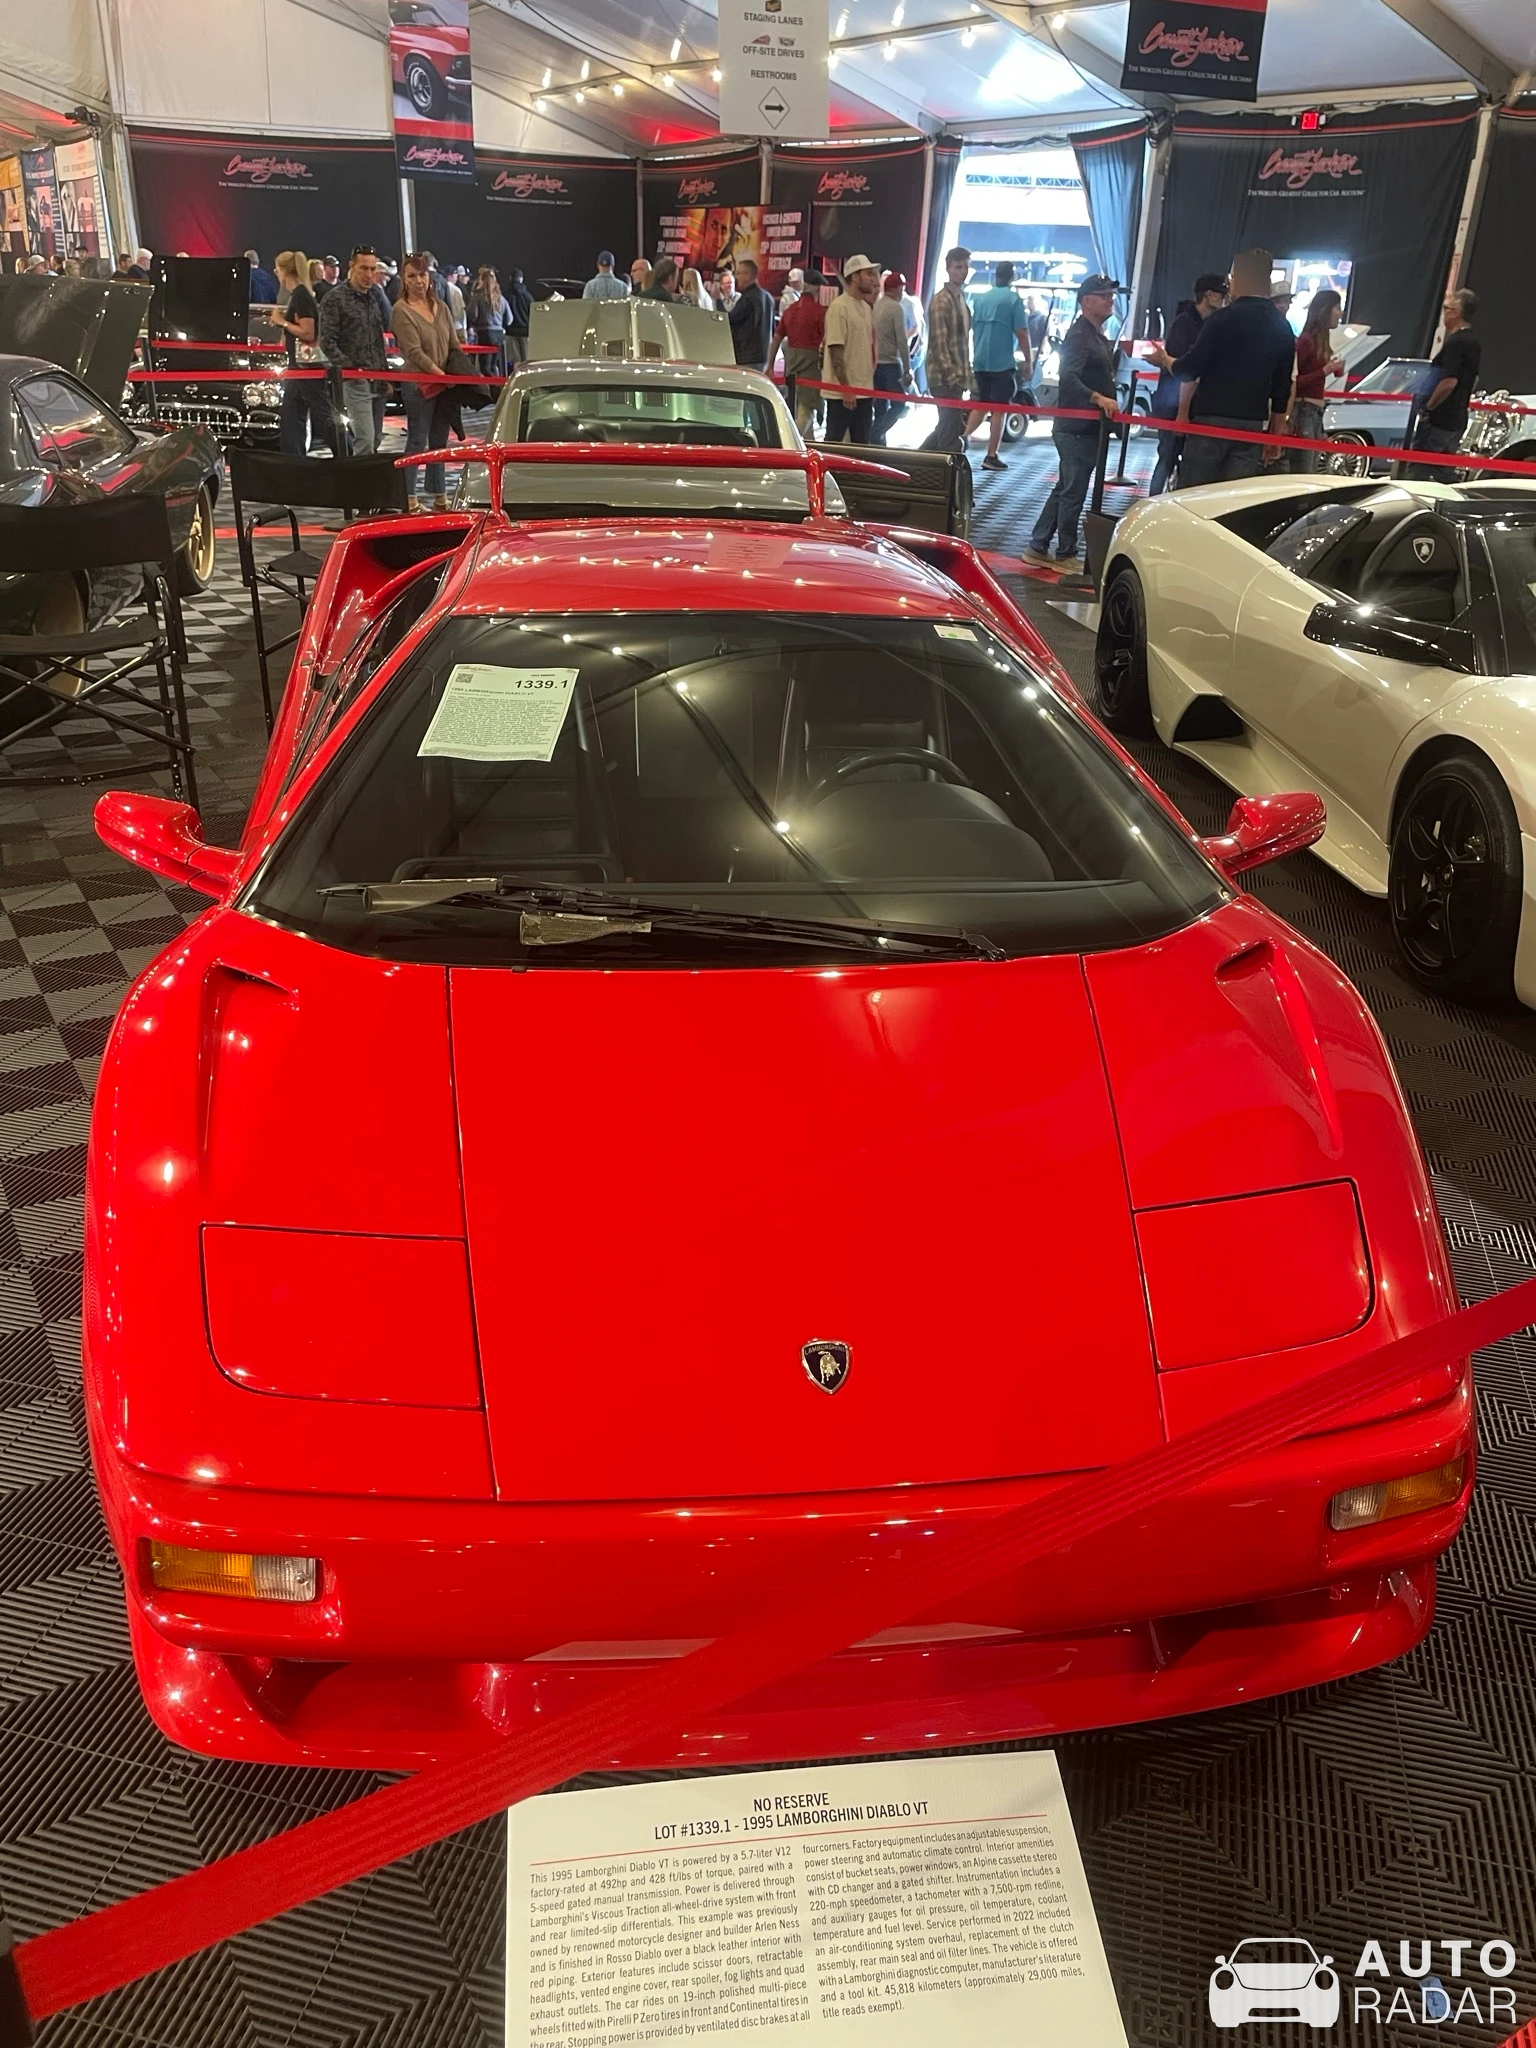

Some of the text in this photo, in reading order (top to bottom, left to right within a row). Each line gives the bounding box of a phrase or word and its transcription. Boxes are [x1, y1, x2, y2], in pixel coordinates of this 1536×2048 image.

[744, 12, 803, 25] STAGING LANES
[743, 45, 805, 58] OFF-SITE DRIVES
[751, 70, 797, 80] RESTROOMS
[515, 680, 568, 689] 1339.1
[804, 1344, 846, 1355] LAMBORGHINI
[753, 1792, 829, 1812] NO RESERVE
[654, 1825, 675, 1840] LOT
[680, 1820, 730, 1838] #1339.1
[744, 1816, 773, 1832] 1995
[776, 1807, 863, 1829] LAMBORGHINI
[866, 1803, 911, 1821] DIABLO
[913, 1801, 927, 1816] VT
[530, 1872, 547, 1884] This
[551, 1869, 572, 1881] 1995
[575, 1863, 627, 1879] Lamborghini
[629, 1860, 656, 1873] Diablo
[658, 1858, 668, 1870] VT
[672, 1858, 679, 1868] is
[682, 1853, 717, 1869] powered
[719, 1852, 729, 1865] by
[740, 1848, 771, 1861] 5.7-liter
[775, 1845, 791, 1857] V12
[530, 1881, 585, 1898] factory-rated
[588, 1881, 596, 1892] at
[600, 1878, 627, 1891] 492hp
[630, 1875, 645, 1887] and
[649, 1873, 665, 1885] 428
[668, 1871, 691, 1883] ft/lbs
[694, 1869, 702, 1880] of
[705, 1868, 734, 1880] torque,
[738, 1862, 764, 1878] paired
[767, 1860, 784, 1872] with
[530, 1873, 795, 1914] 5-speed gated manual transmission. Power is delivered through
[809, 1897, 847, 1911] 220-mph
[850, 1894, 905, 1909] speedometer,
[914, 1889, 960, 1902] tachometer
[963, 1885, 980, 1897] with
[991, 1882, 1032, 1896] 7,500-rpm
[1034, 1879, 1064, 1891] redline,
[811, 1893, 1067, 1925] and auxiliary gauges for oil pressure, oil temperature, coolant
[530, 1903, 798, 1943] and rear limited-slip differentials. This example was previously
[530, 1919, 800, 1958] owned by renowned motorcycle designer and builder Arlen Ness
[813, 1906, 1071, 1942] temperature and fuel level. Service performed in 2022 included
[815, 1920, 1074, 1956] an air-conditioning system overhaul, replacement of the clutch
[530, 1947, 803, 1989] red piping. Exterior features include scissor doors, retractable
[821, 1989, 836, 2002] and
[848, 1986, 865, 1999] tool
[867, 1985, 881, 1997] kit.
[884, 1981, 915, 1996] 45,818
[917, 1979, 961, 1992] kilometers
[964, 1971, 1024, 1990] (approximately
[1029, 1968, 1058, 1983] 29,000
[1060, 1966, 1084, 1979] miles,
[530, 1979, 807, 2020] exhaust outlets. The car rides on 19-inch polished multi-piece
[822, 1999, 903, 2018] title reads exempt).
